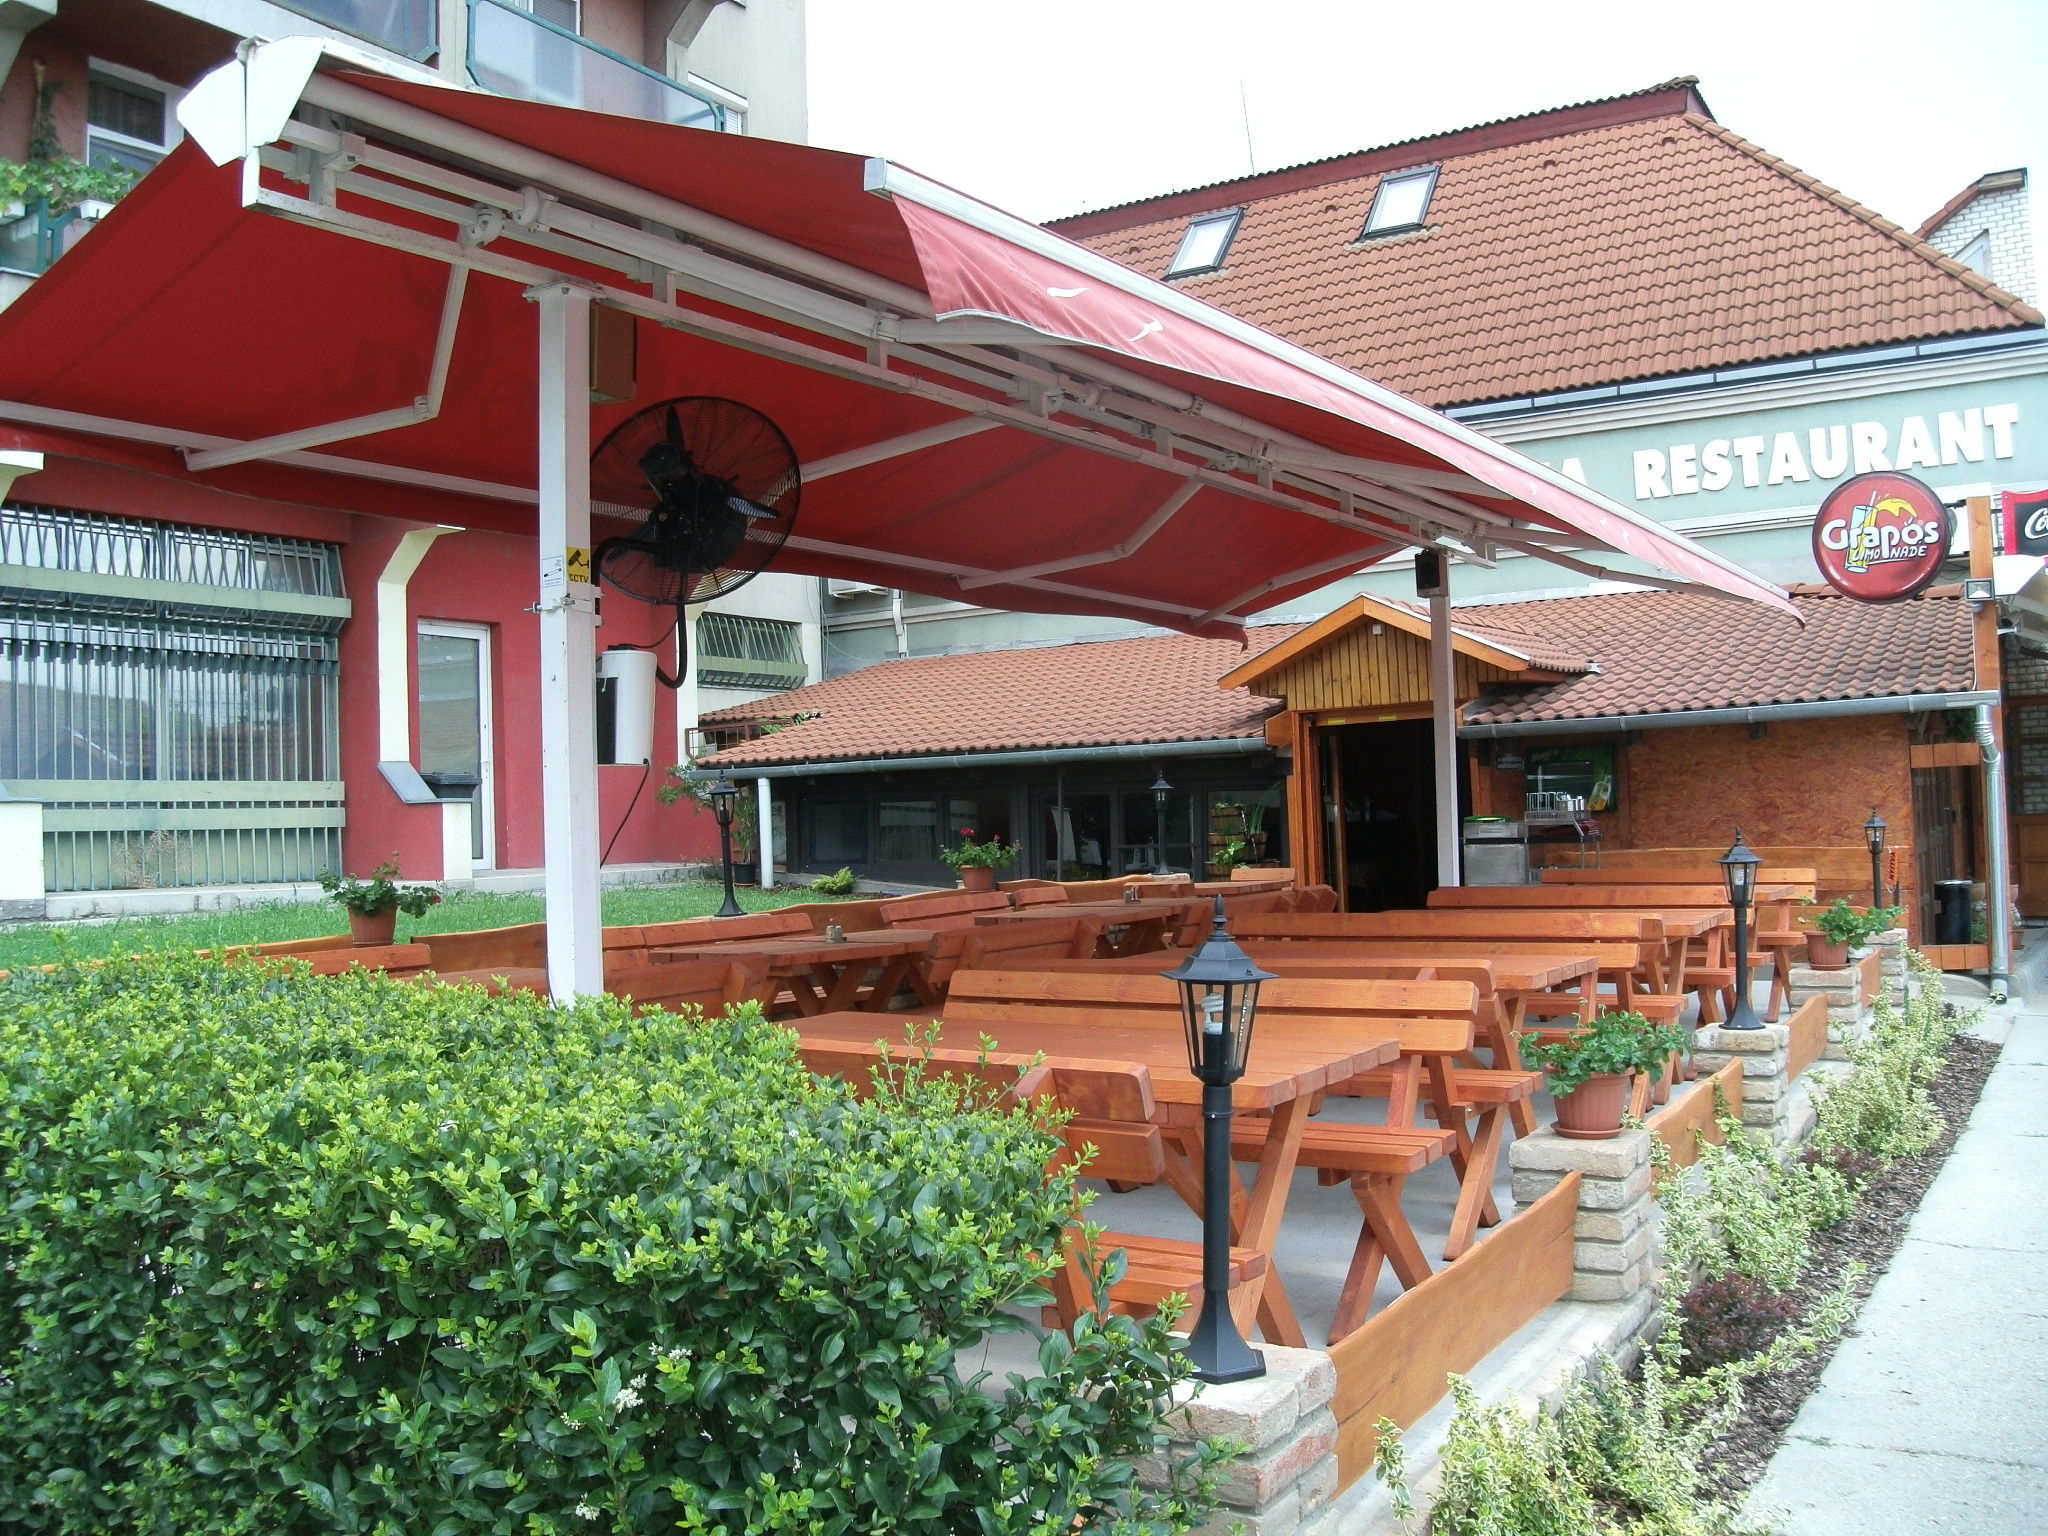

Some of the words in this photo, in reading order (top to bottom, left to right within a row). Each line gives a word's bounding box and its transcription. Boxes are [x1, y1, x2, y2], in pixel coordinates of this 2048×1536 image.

[1632, 402, 2019, 500] RESTAURANT
[1821, 518, 1940, 559] Grapos
[2024, 507, 2048, 539] Co
[568, 573, 589, 583] CCTV
